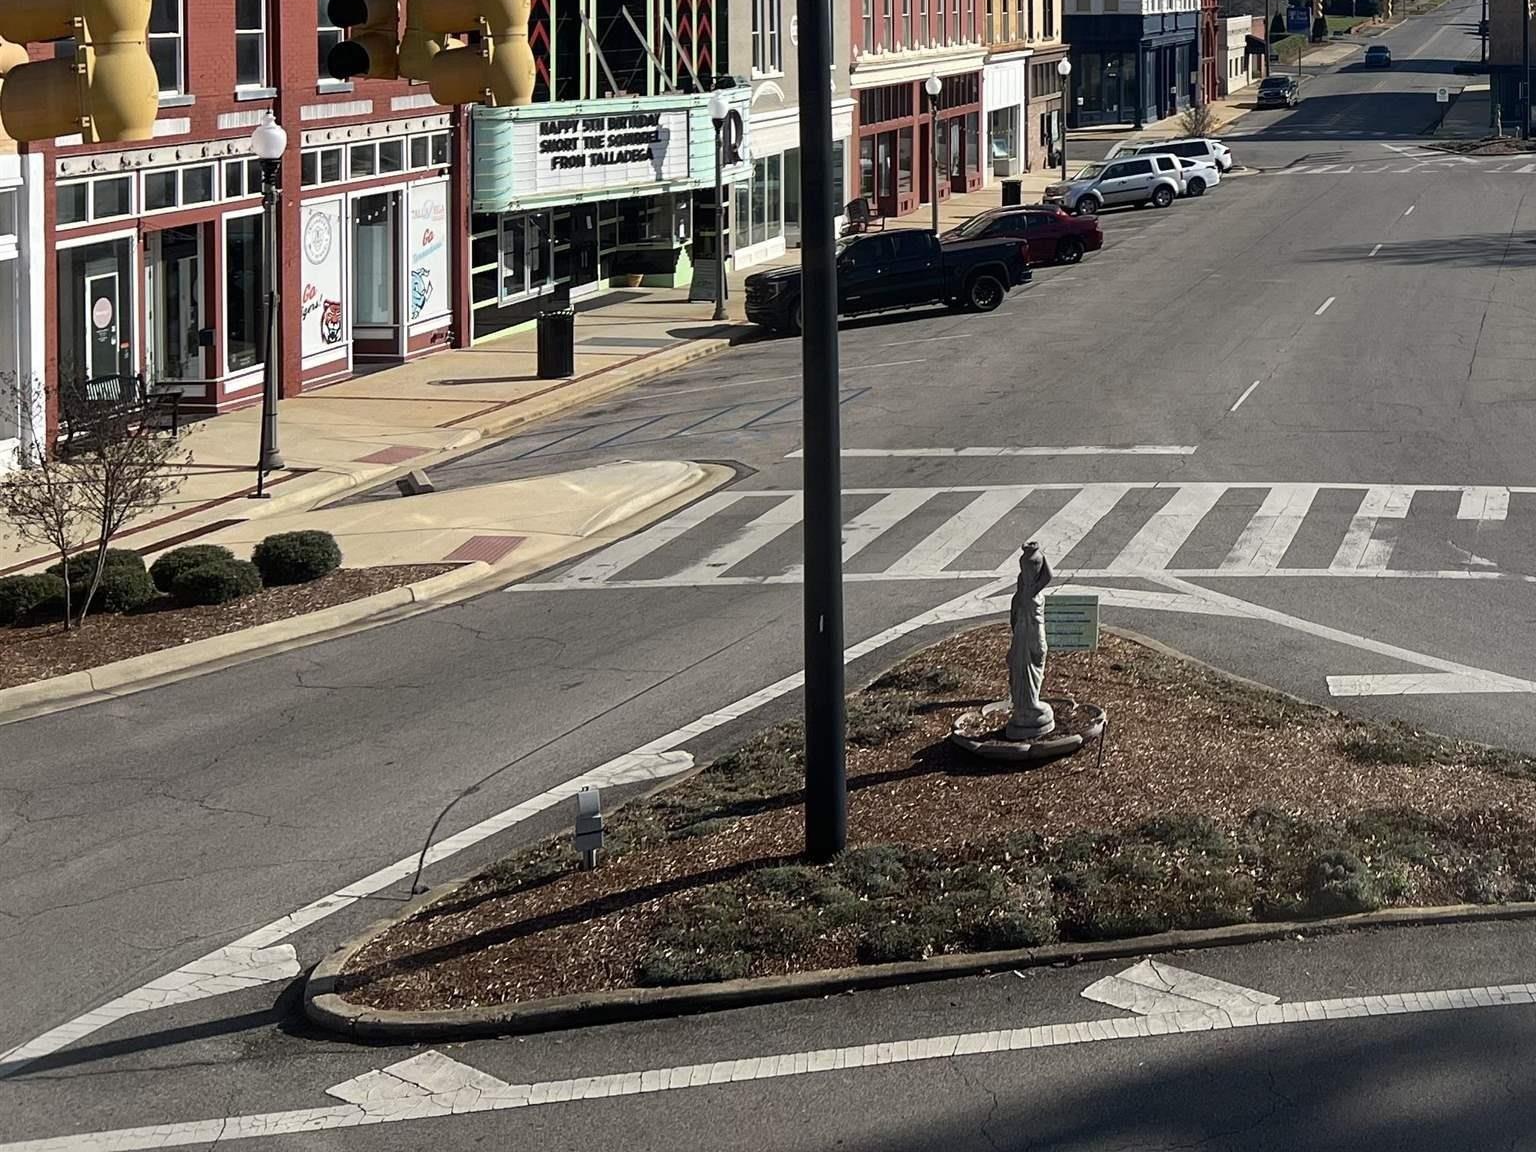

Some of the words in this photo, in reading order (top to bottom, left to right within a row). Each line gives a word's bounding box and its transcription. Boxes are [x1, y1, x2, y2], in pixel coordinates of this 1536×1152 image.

[540, 119, 580, 136] HAPPY
[582, 118, 605, 132] 5TH
[607, 112, 661, 131] BIRTHDAY
[539, 137, 579, 154] SHORT
[582, 135, 605, 150] THE
[607, 130, 662, 148] SQUIRREL
[551, 154, 586, 171] FROM
[589, 146, 654, 167] TALLADEGA
